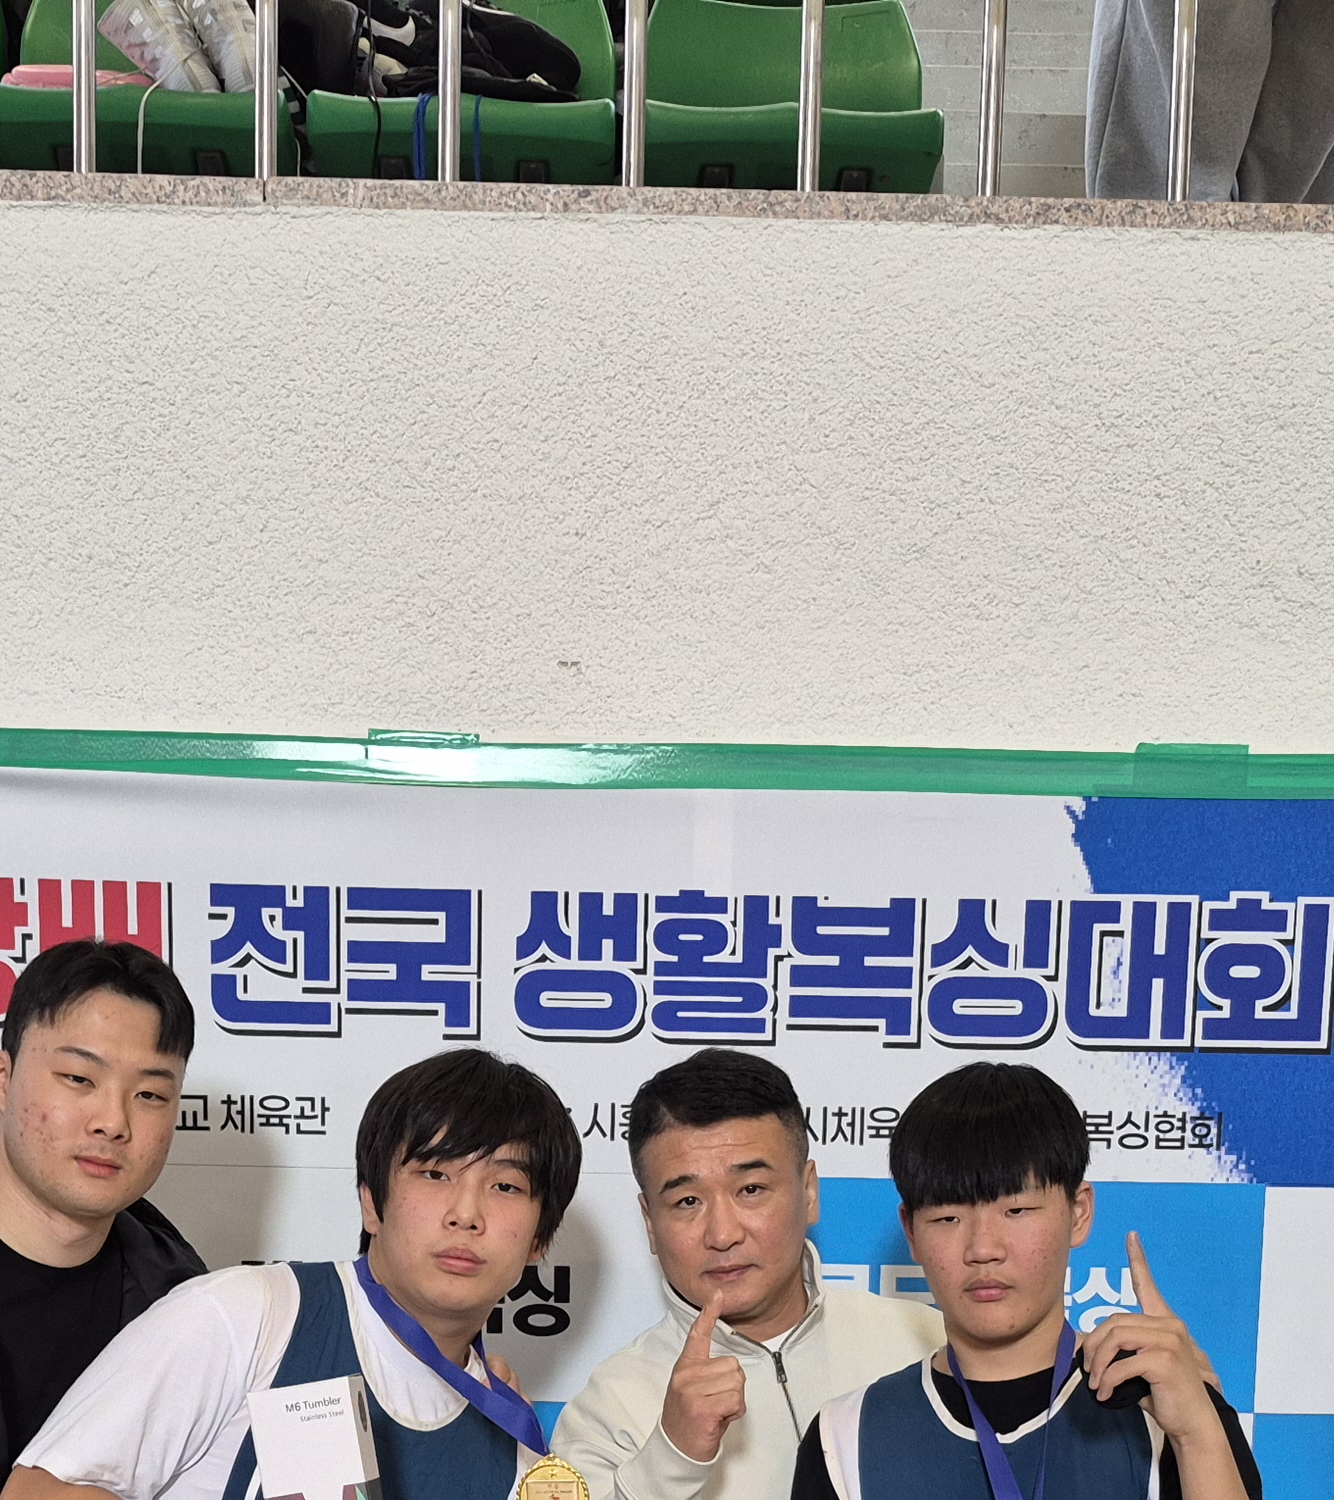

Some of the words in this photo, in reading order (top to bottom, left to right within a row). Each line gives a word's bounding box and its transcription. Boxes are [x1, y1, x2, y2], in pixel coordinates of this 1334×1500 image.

[208, 882, 482, 1041] 전국
[220, 1094, 330, 1136] 체육관
[285, 1401, 301, 1413] M6
[302, 1396, 341, 1410] Tumbler
